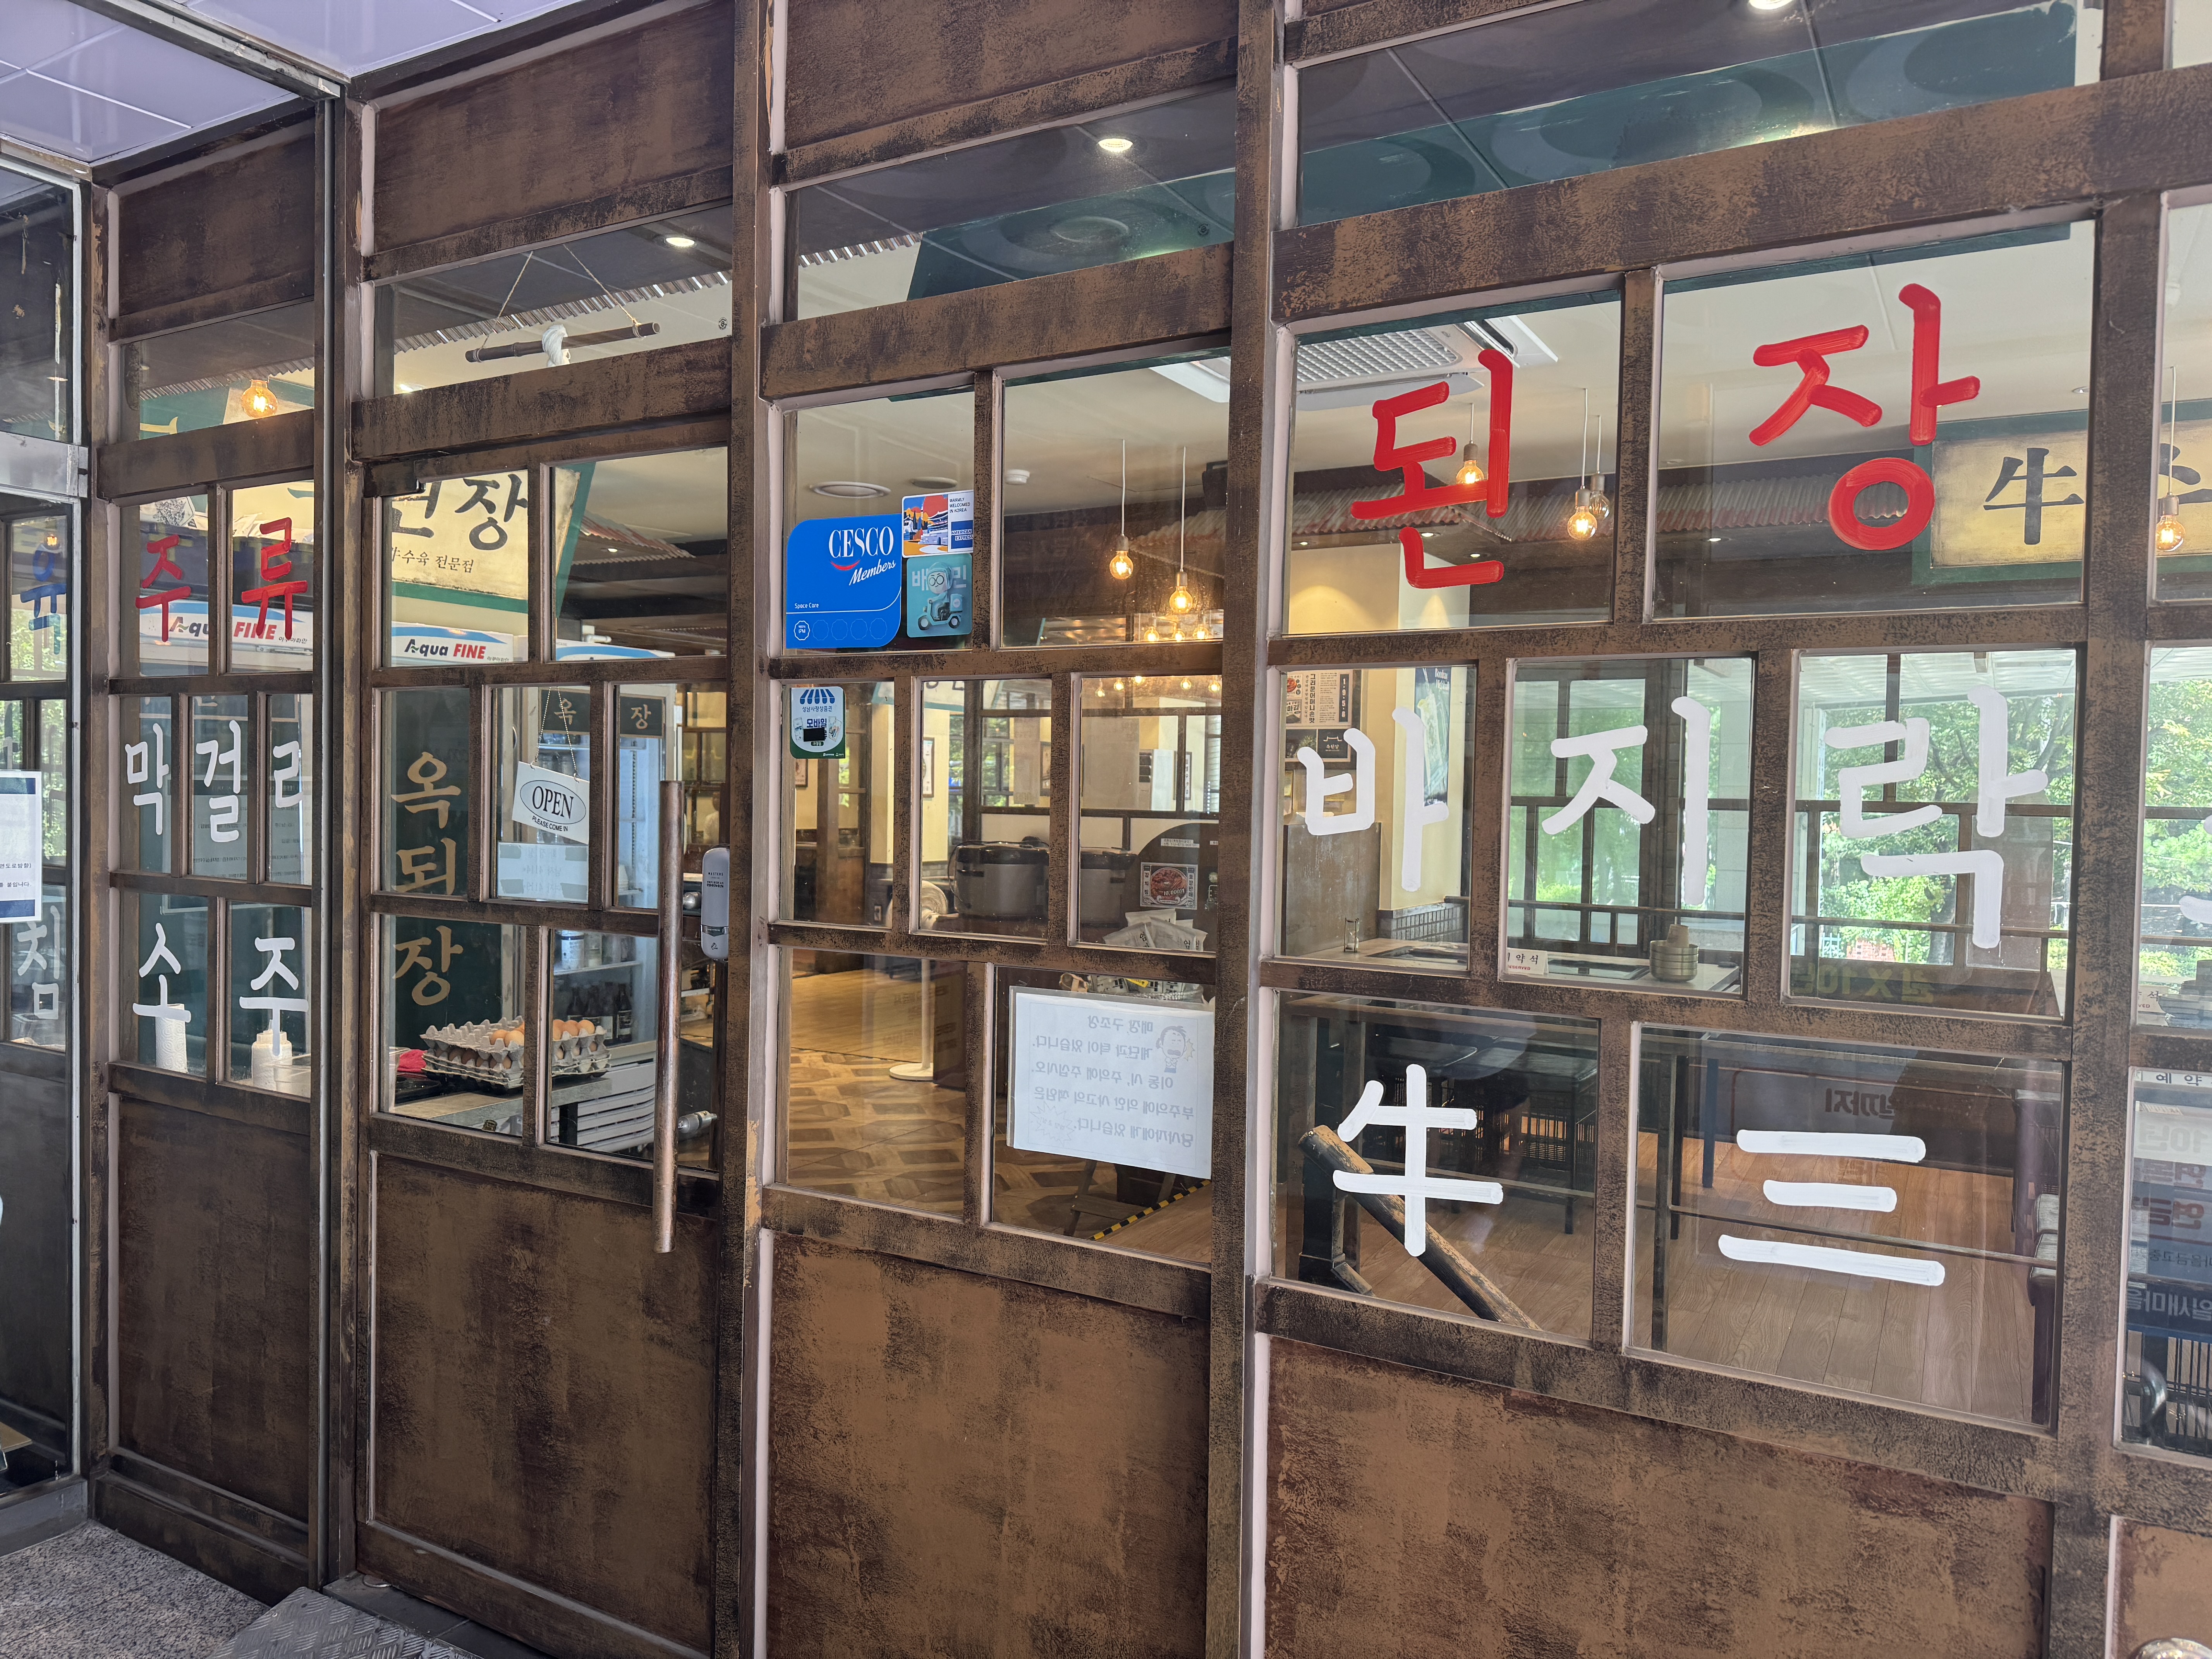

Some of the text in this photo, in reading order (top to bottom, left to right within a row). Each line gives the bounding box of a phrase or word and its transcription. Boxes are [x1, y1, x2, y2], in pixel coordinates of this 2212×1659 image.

[1351, 283, 1980, 588] 된장
[829, 526, 893, 558] CESCO
[435, 555, 474, 573] 전문점
[848, 559, 896, 586] Members
[135, 517, 308, 643] 주류
[169, 617, 277, 640] Aqu FINE
[404, 639, 486, 659] Aqua FINE
[807, 718, 827, 728] 모바일
[532, 785, 574, 820] OPEN
[532, 815, 549, 828] PLEASE
[1297, 684, 2049, 951] 바지락
[133, 923, 308, 1056] 소주
